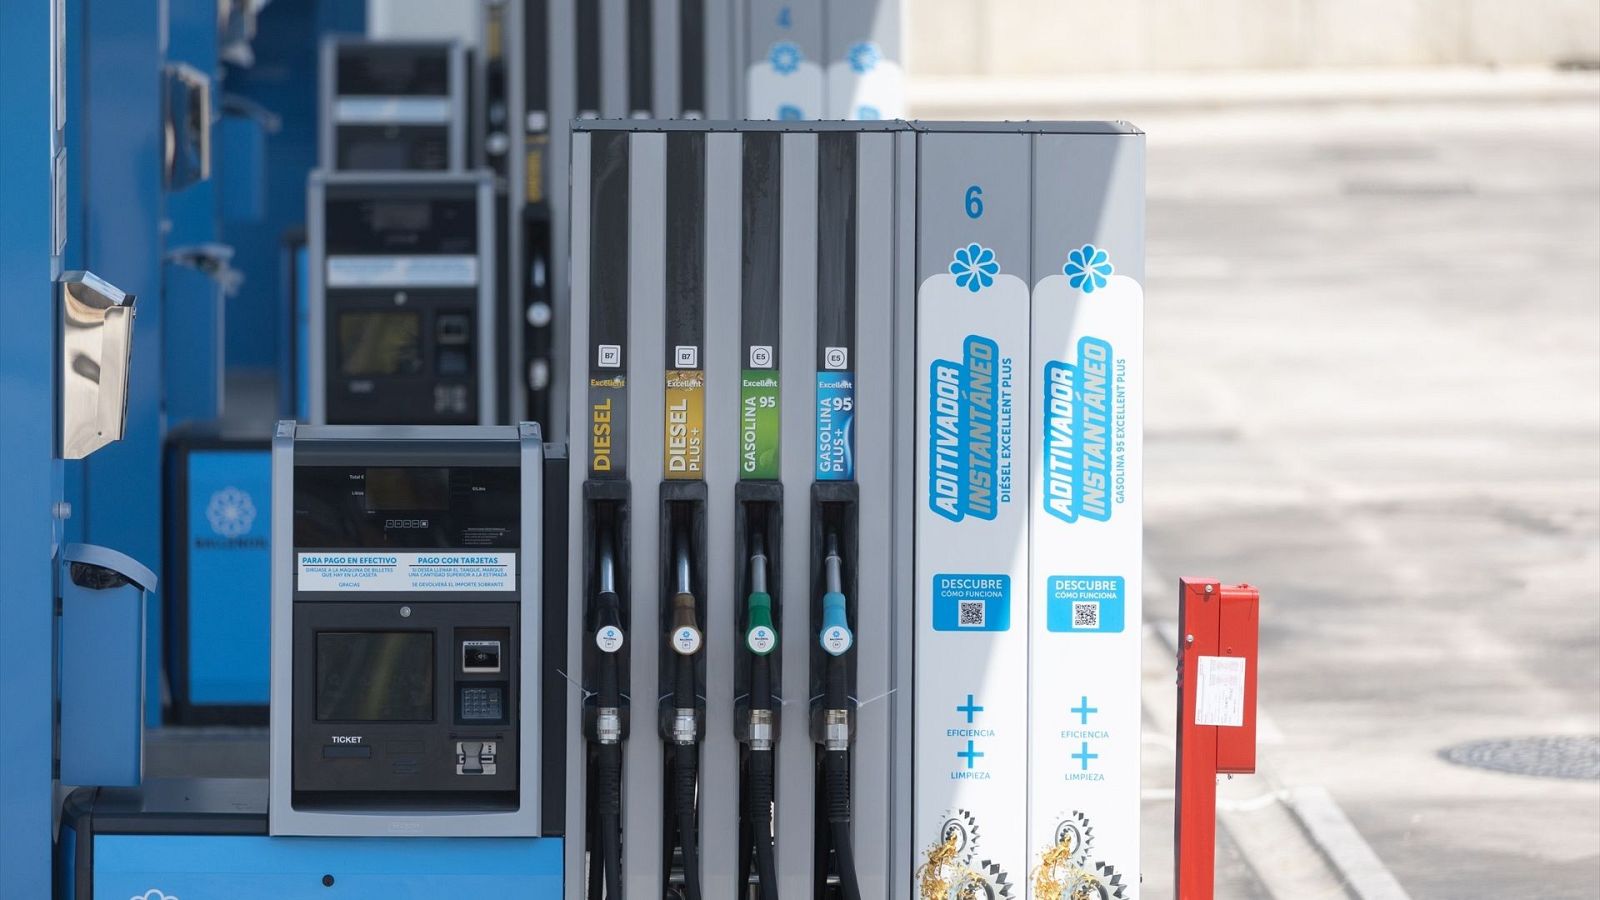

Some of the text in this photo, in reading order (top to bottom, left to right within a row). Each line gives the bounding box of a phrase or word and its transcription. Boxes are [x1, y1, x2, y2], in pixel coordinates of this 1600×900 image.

[965, 185, 983, 219] 6
[605, 352, 614, 360] B7
[831, 354, 840, 362] E5
[591, 379, 625, 388] Excellent
[667, 379, 701, 388] Excellent
[743, 379, 777, 387] Excellent
[819, 381, 852, 389] Excellent
[759, 396, 776, 408] 95
[832, 397, 852, 411] 95
[962, 342, 992, 513] INSTANTÁNEO
[999, 358, 1012, 502] DIÉSEL EXCELLENT PLUS
[1075, 342, 1106, 515] INSTANTÁNEO
[1116, 358, 1125, 504] GASOLINA 95 EXCELLENT PLUS
[594, 398, 610, 471] DIESEL
[670, 398, 687, 472] DIESEL
[744, 396, 756, 472] GASOLINA
[820, 398, 832, 472] GASOLINA
[936, 366, 959, 516] ADITIVADOR
[1050, 367, 1073, 517] ADITIVADOR
[689, 428, 700, 472] PLUS+
[833, 428, 844, 472] PLUS+
[942, 579, 1003, 589] DESCUBRE
[1056, 581, 1117, 590] DESCUBRE
[1055, 591, 1078, 599] CÓMO
[947, 729, 995, 737] EFICIENCIA
[1061, 731, 1109, 739] EFICIENCIA
[332, 736, 362, 744] TICKET
[951, 771, 991, 780] LIMPIEZA
[1065, 773, 1105, 781] LIMPIEZA
